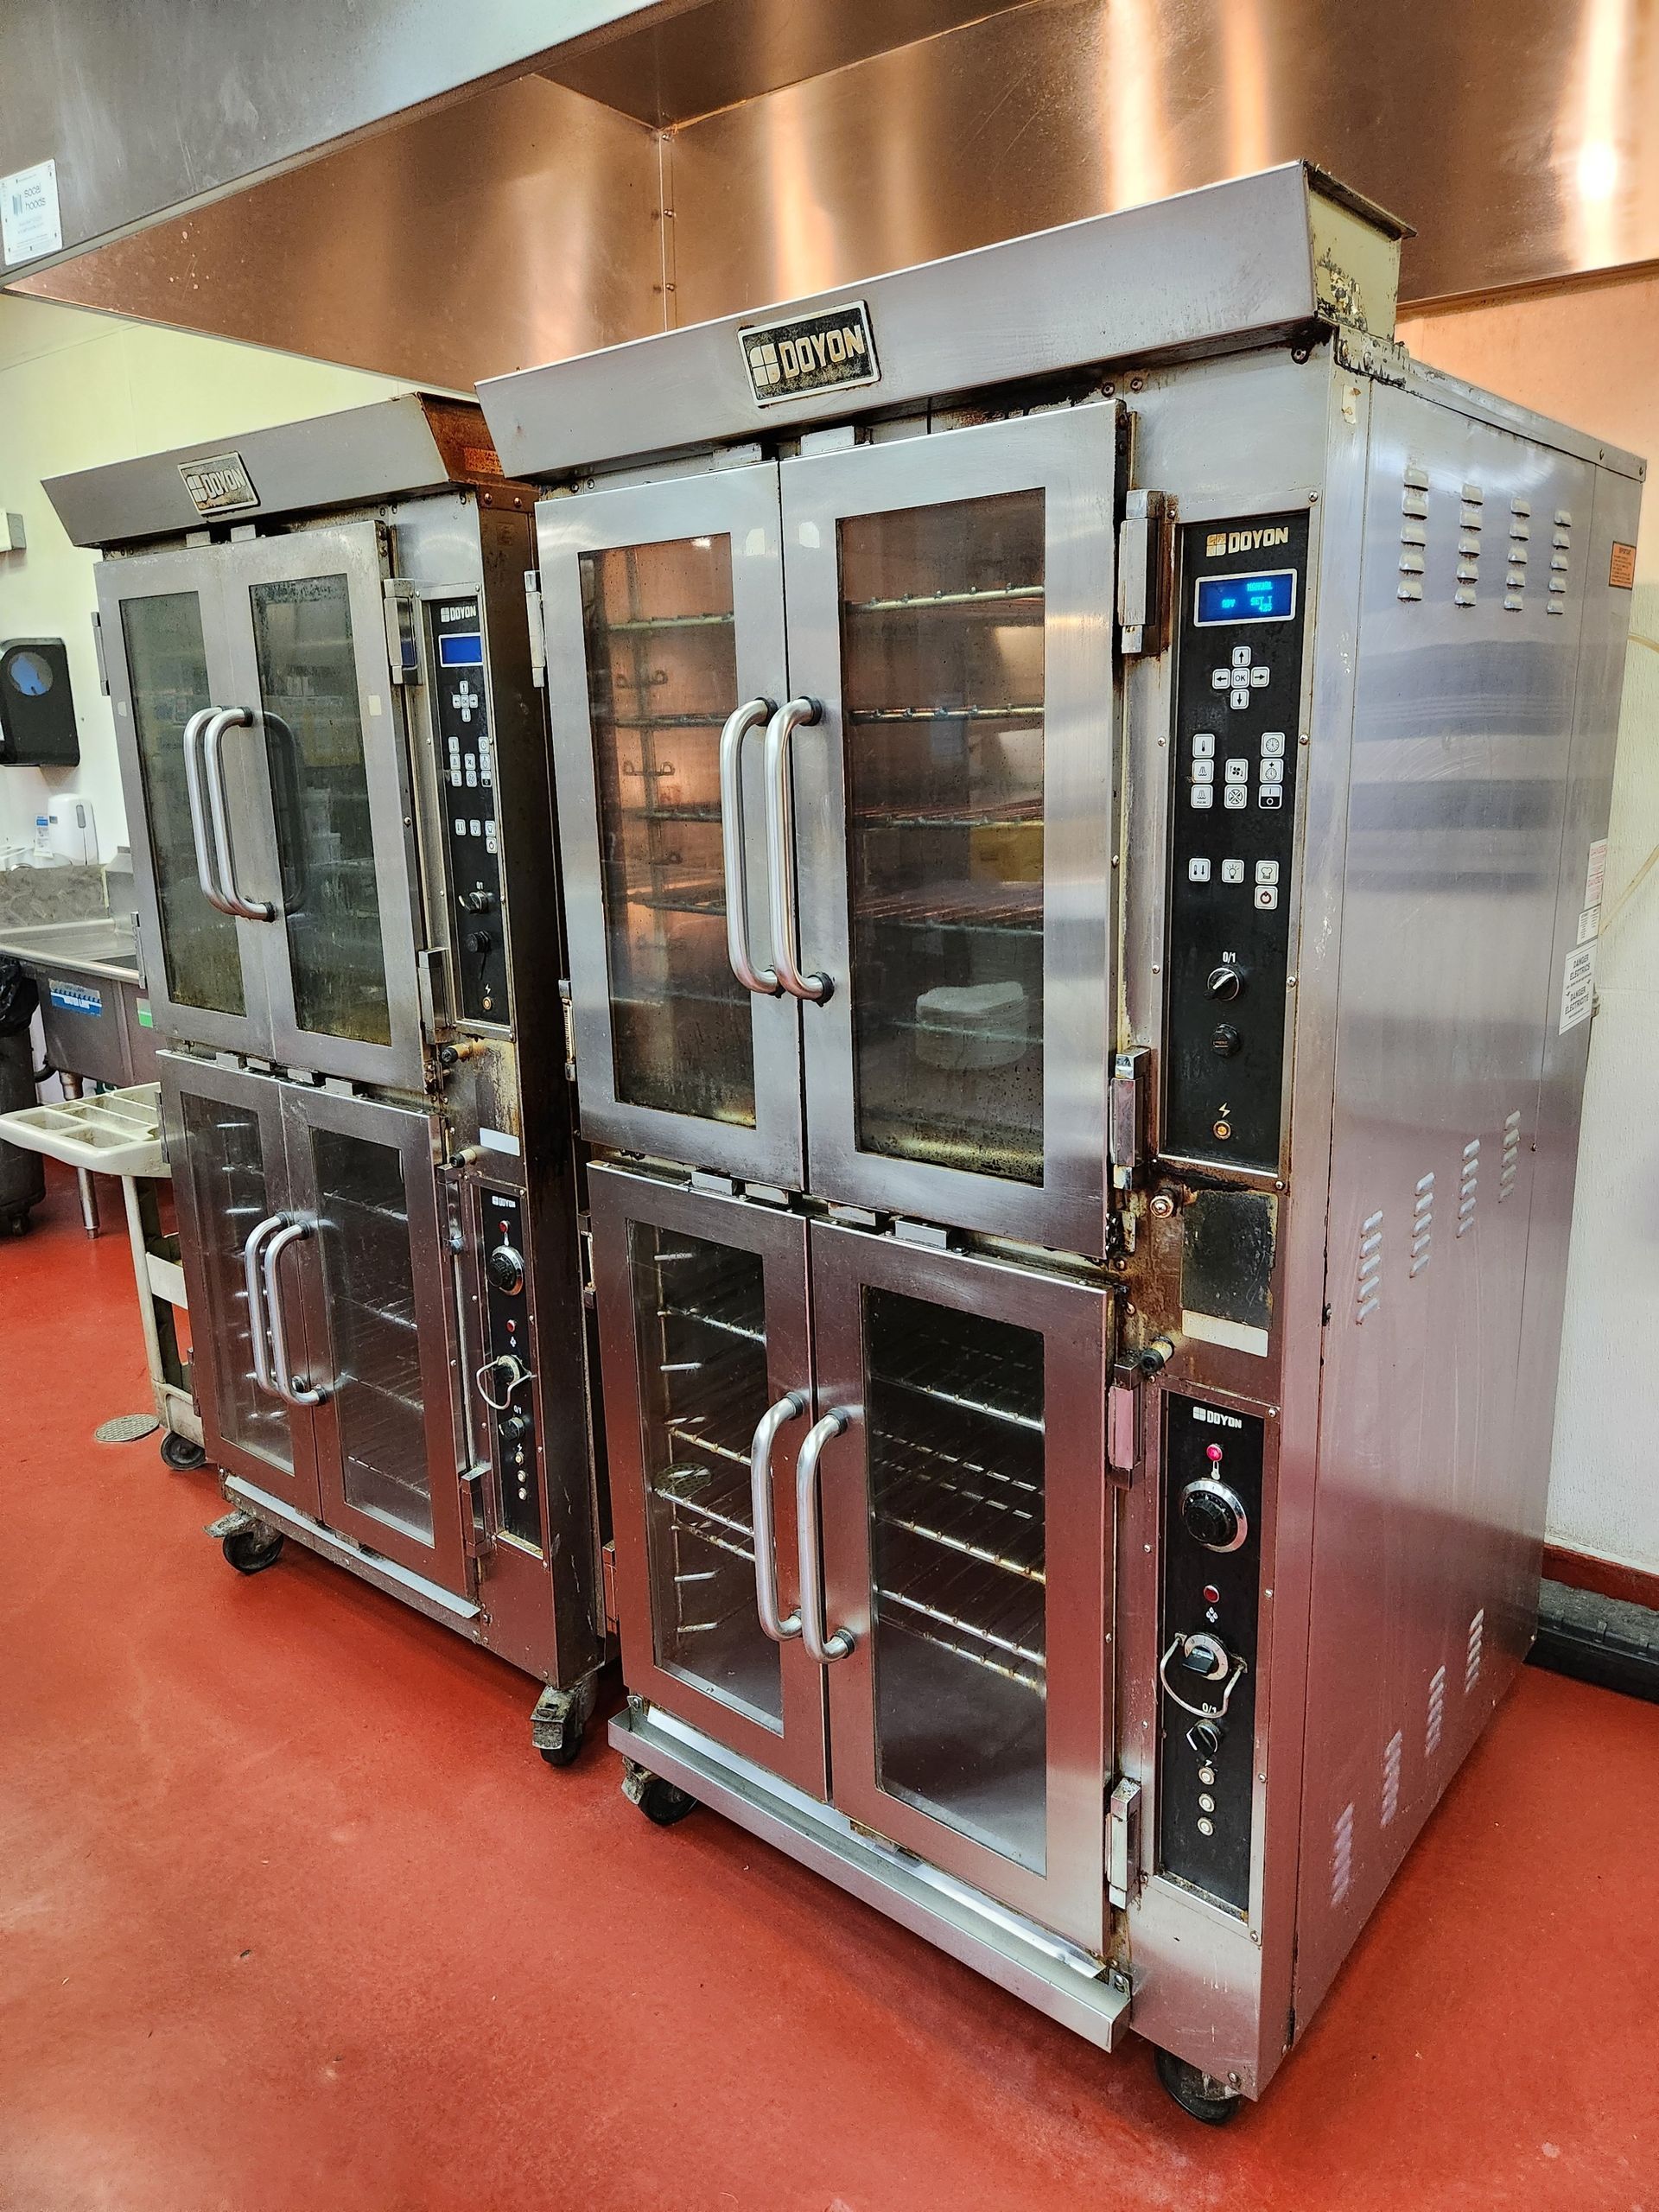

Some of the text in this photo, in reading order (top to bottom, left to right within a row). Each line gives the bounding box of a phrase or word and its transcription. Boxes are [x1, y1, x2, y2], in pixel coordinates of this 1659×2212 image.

[779, 324, 866, 378] DOYON
[200, 468, 246, 499] DOYON
[1228, 527, 1289, 554] DOYON
[449, 606, 476, 621] DOYON
[1222, 951, 1236, 963] 0/1
[1206, 1410, 1242, 1428] DOYON
[1202, 1702, 1217, 1714] 0/1
